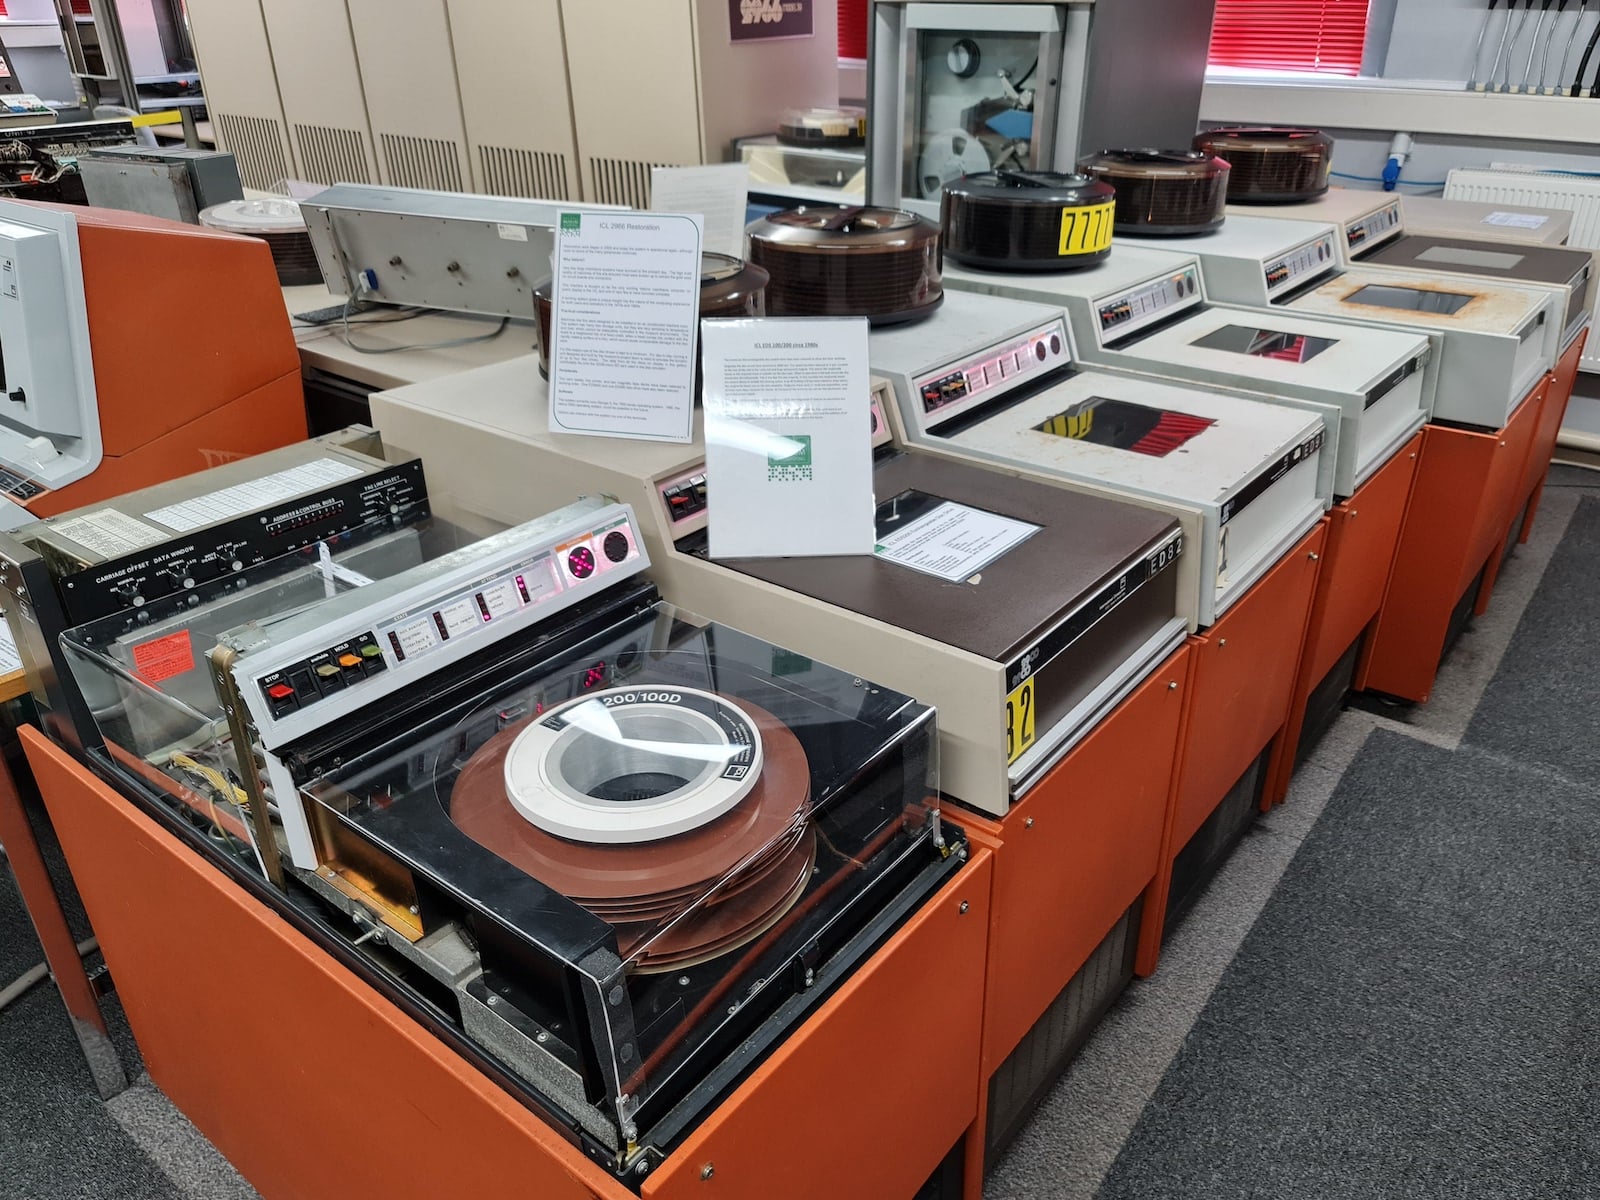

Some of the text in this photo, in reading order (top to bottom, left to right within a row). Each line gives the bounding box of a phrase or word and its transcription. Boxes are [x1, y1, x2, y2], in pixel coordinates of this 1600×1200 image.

[600, 222, 609, 230] ICL
[627, 223, 661, 231] Restoration
[273, 510, 295, 522] ADDRESS
[299, 502, 322, 513] CONTROL
[153, 553, 170, 564] DATA
[170, 545, 195, 558] WINDOW
[1150, 539, 1183, 575] ED82
[95, 560, 150, 584] CARRIAGE OFFSET
[334, 643, 350, 653] HOLD
[264, 673, 280, 684] STOP
[603, 692, 682, 707] 200/100D
